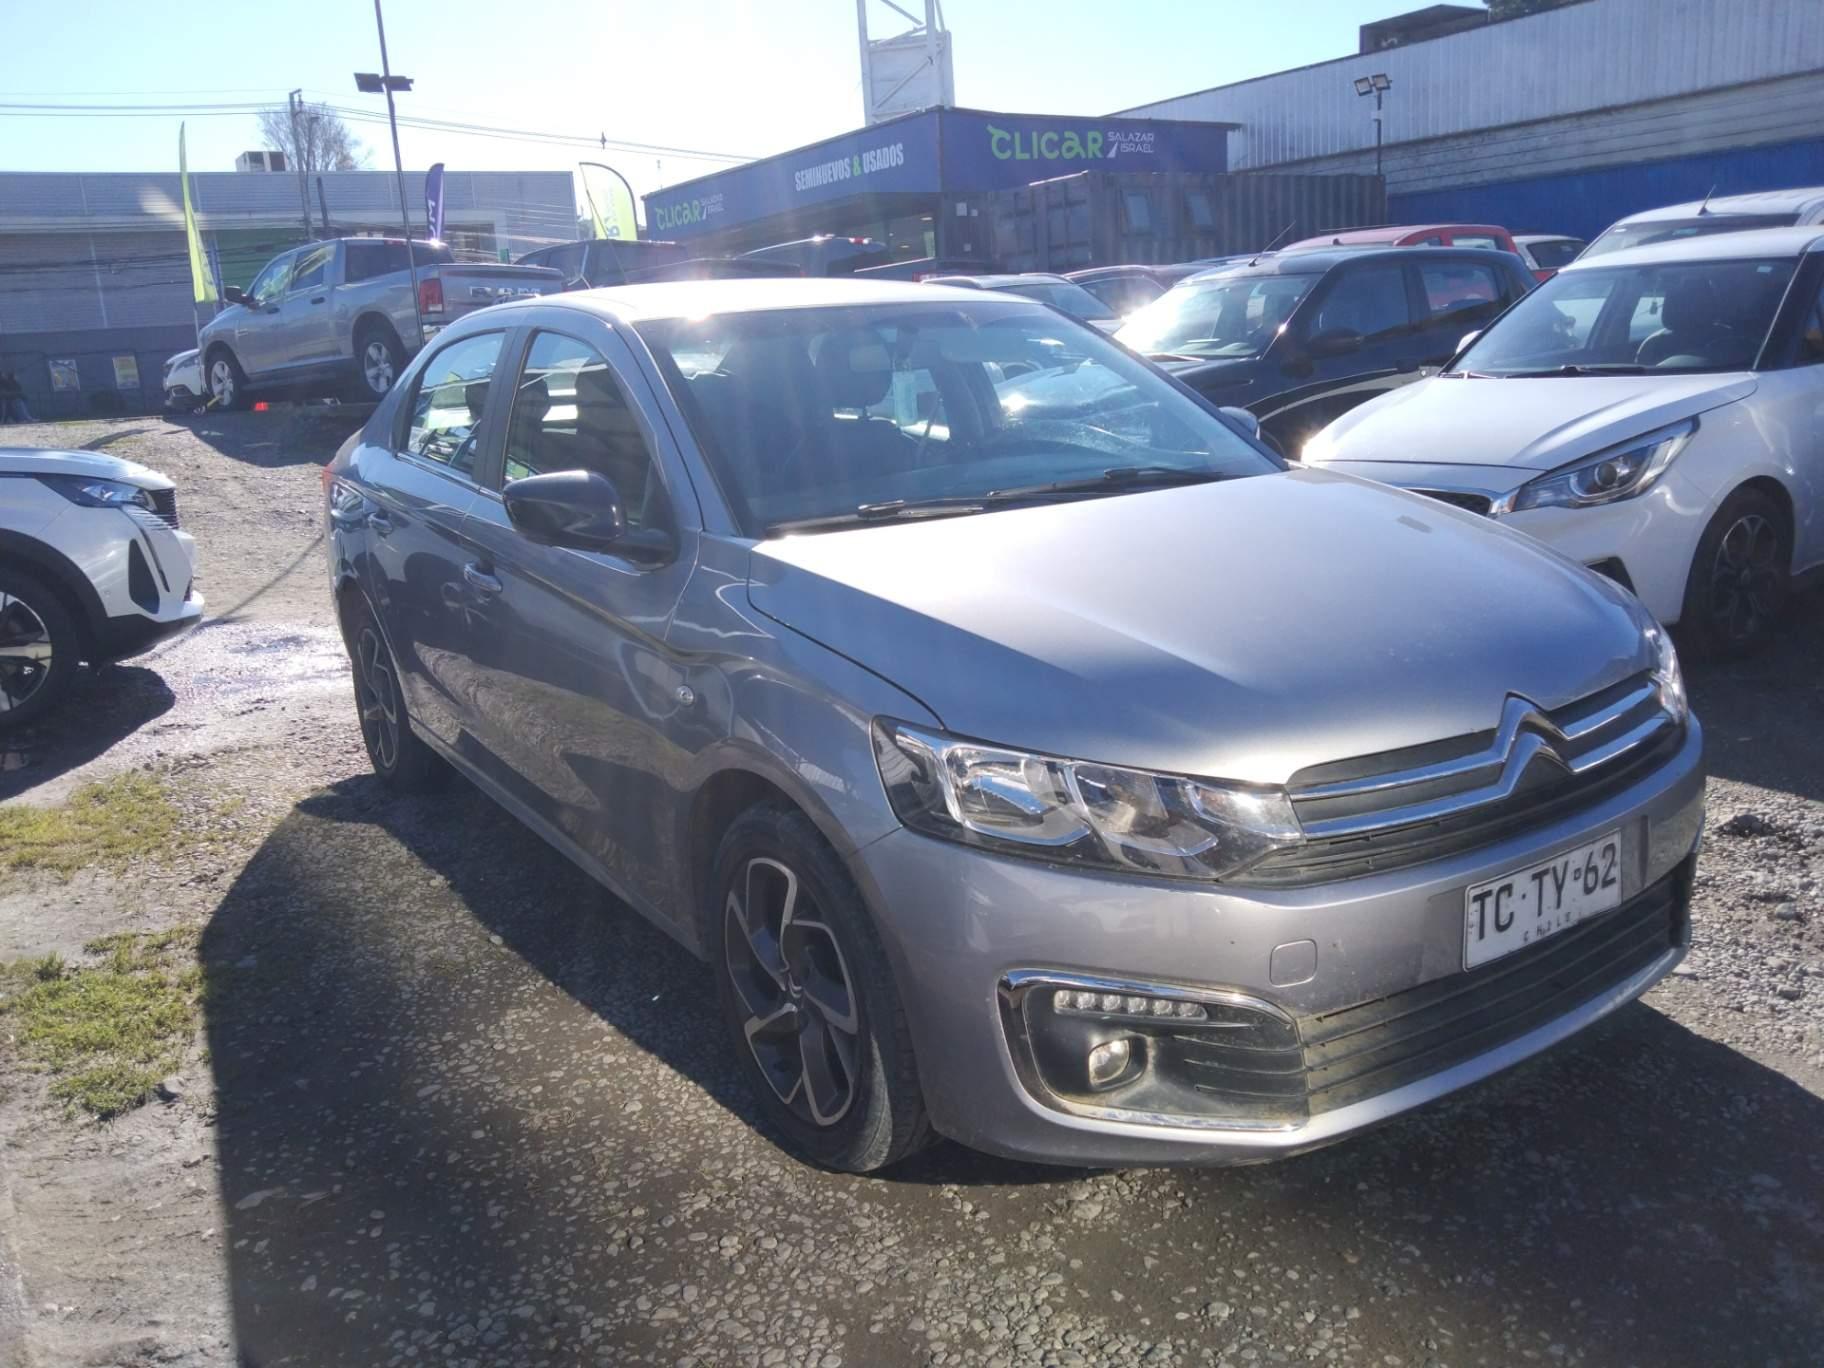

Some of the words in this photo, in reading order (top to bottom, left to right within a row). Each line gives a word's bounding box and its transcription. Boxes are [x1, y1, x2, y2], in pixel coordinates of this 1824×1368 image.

[1107, 131, 1155, 143] SALAZAR
[1120, 143, 1155, 154] ISRAEL
[794, 157, 852, 192] SEMINUEVOS
[852, 154, 862, 177] &
[862, 143, 905, 174] USADOS
